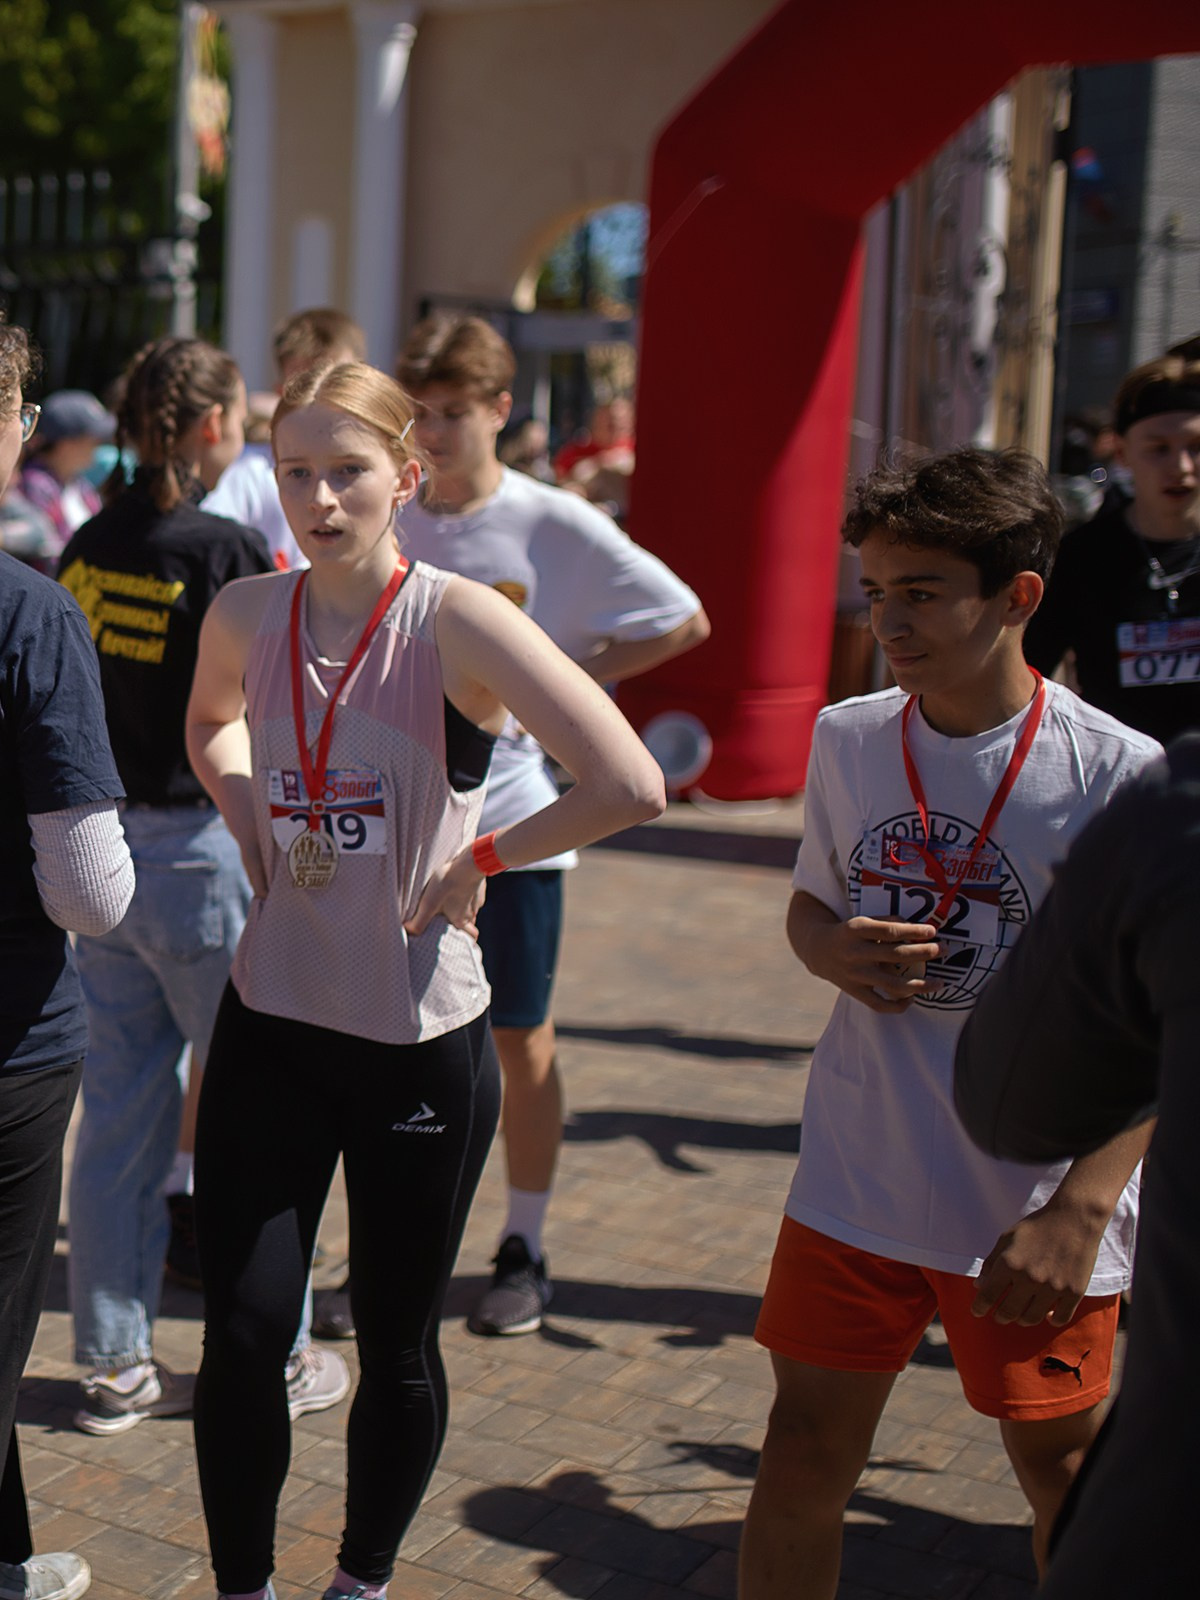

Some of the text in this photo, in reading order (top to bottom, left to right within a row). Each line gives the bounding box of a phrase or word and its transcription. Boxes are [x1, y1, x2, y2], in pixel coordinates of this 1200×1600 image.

[340, 781, 378, 798] ЗАБЕГ
[884, 818, 961, 844] ORLD
[883, 883, 971, 938] 122
[392, 1123, 447, 1134] DEMIX
